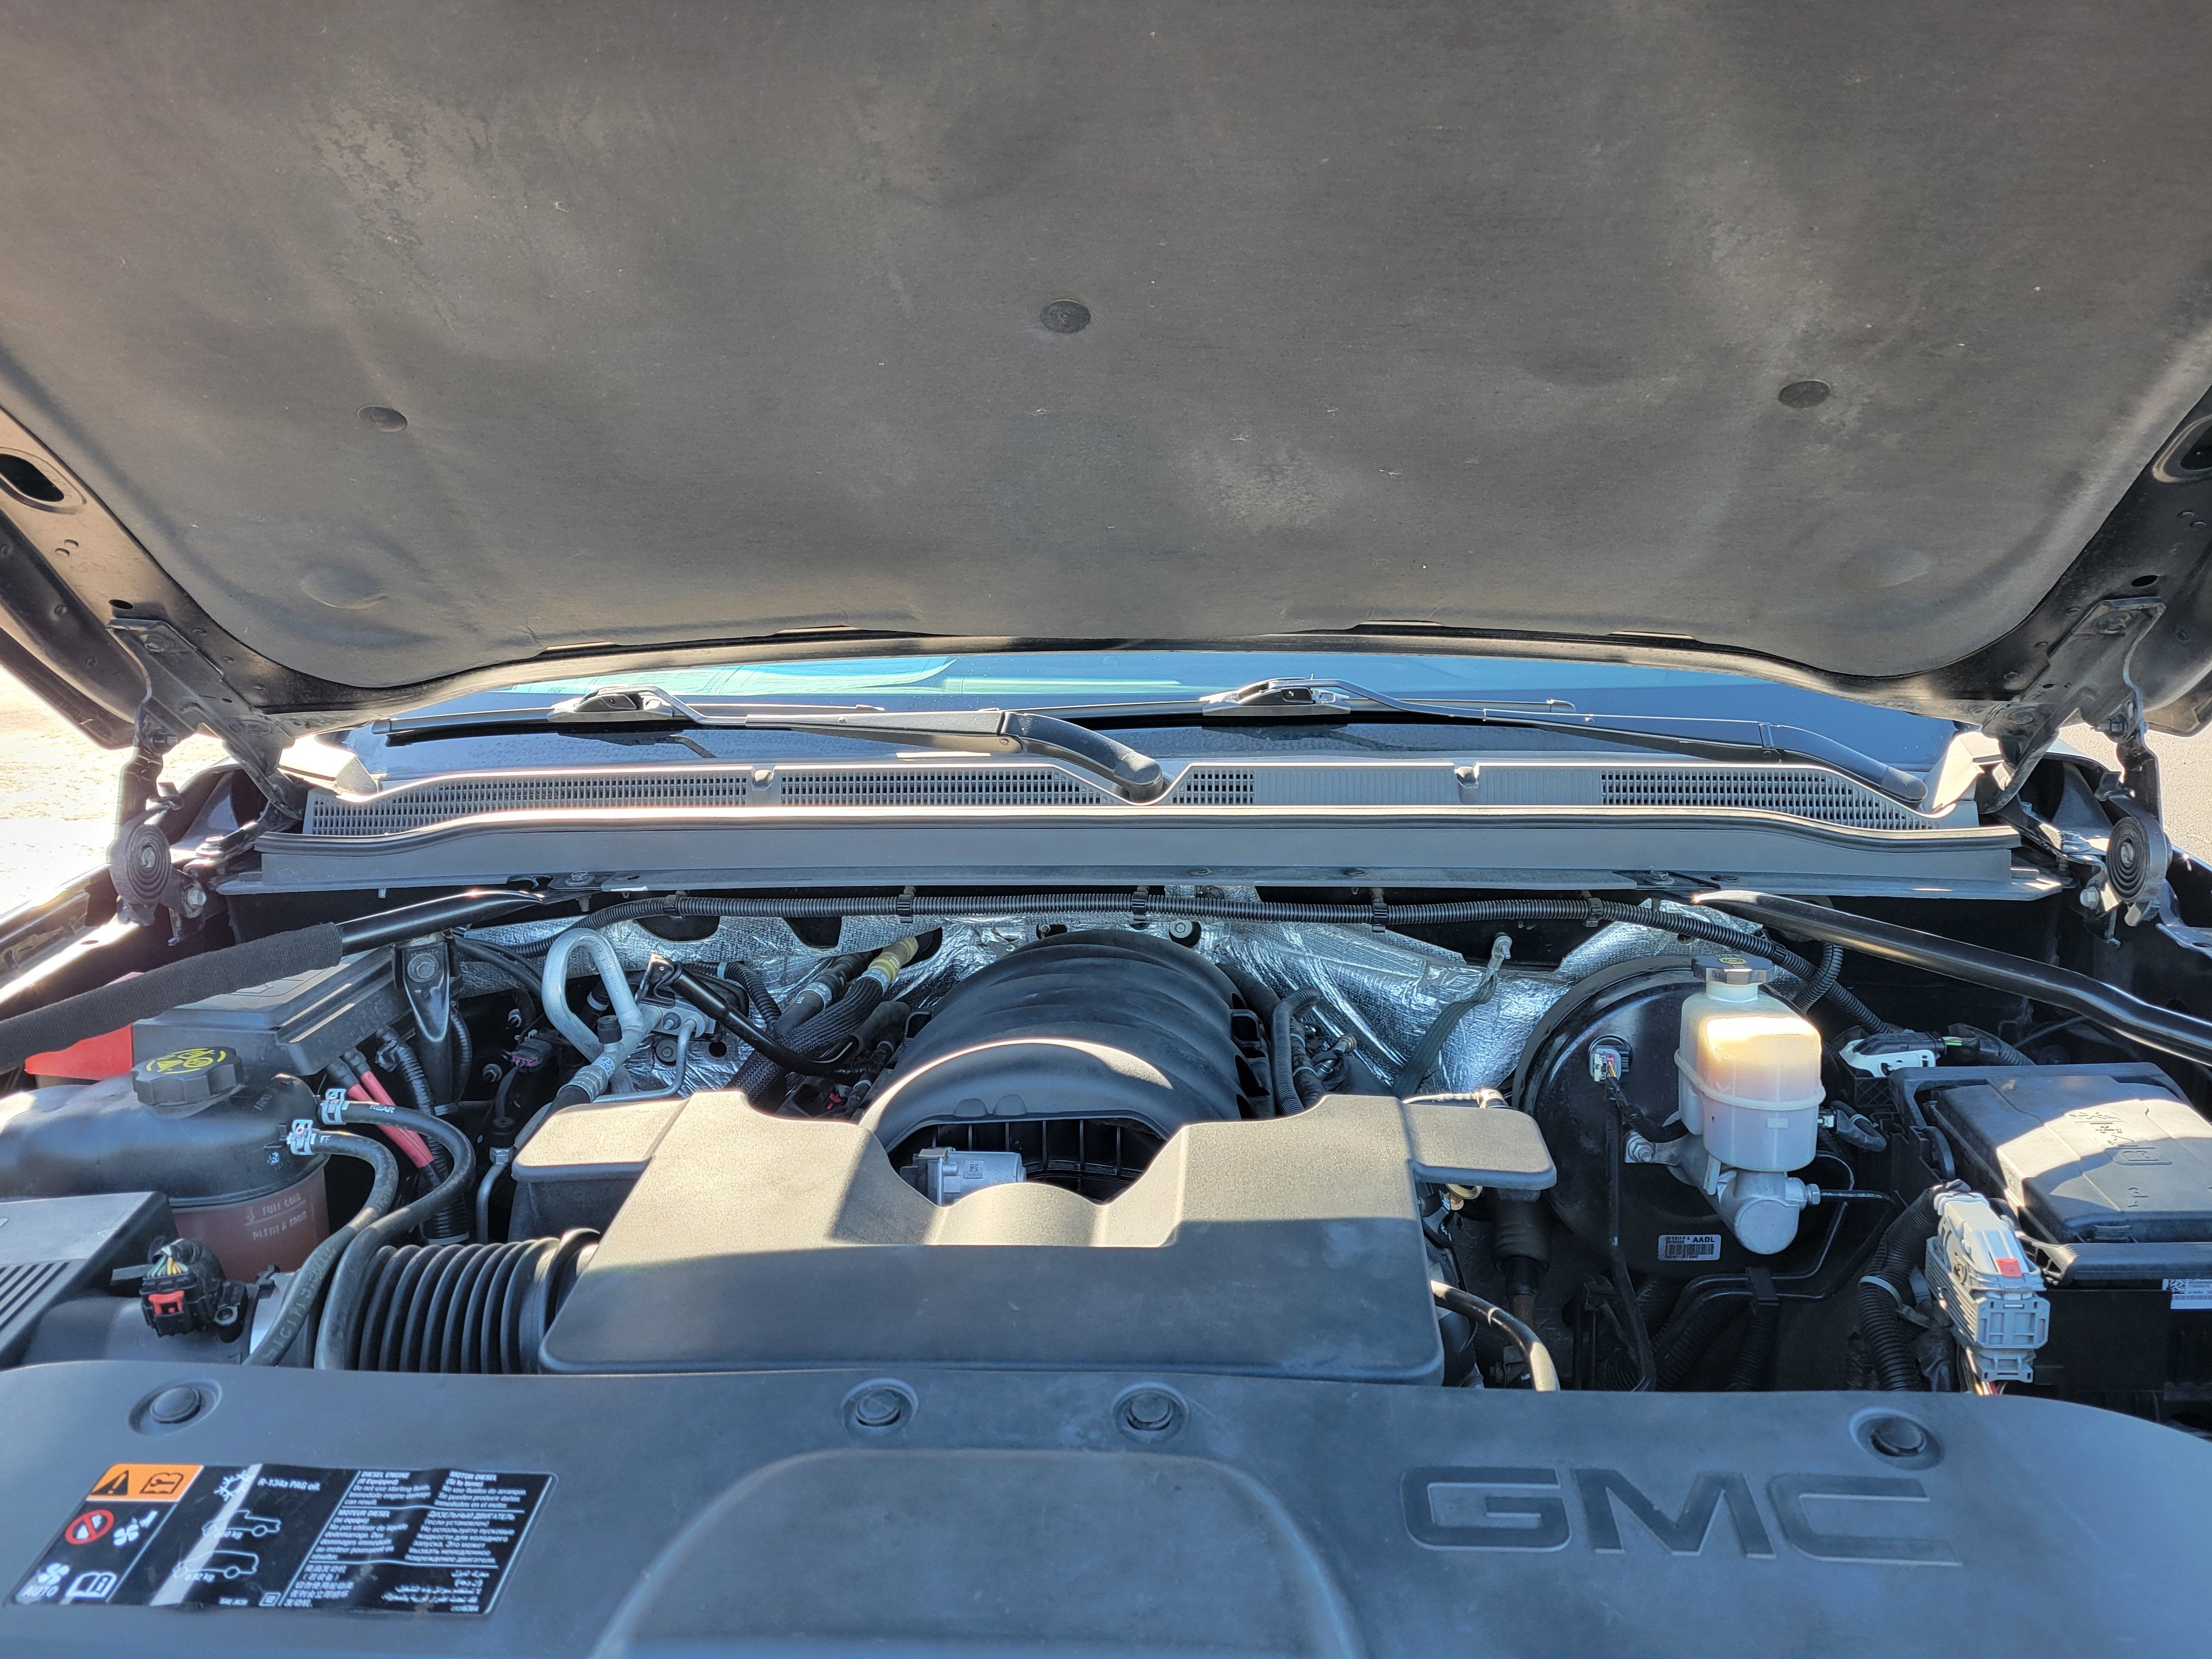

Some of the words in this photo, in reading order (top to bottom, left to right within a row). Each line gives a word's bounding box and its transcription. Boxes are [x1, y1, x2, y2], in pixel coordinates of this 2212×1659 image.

[369, 1105, 395, 1113] REAR
[449, 1471, 475, 1480] MOTOR
[257, 1478, 289, 1487] R-134a
[289, 1480, 307, 1491] PAG
[1398, 1465, 1964, 1567] GMC
[22, 1585, 59, 1598] AUTO
